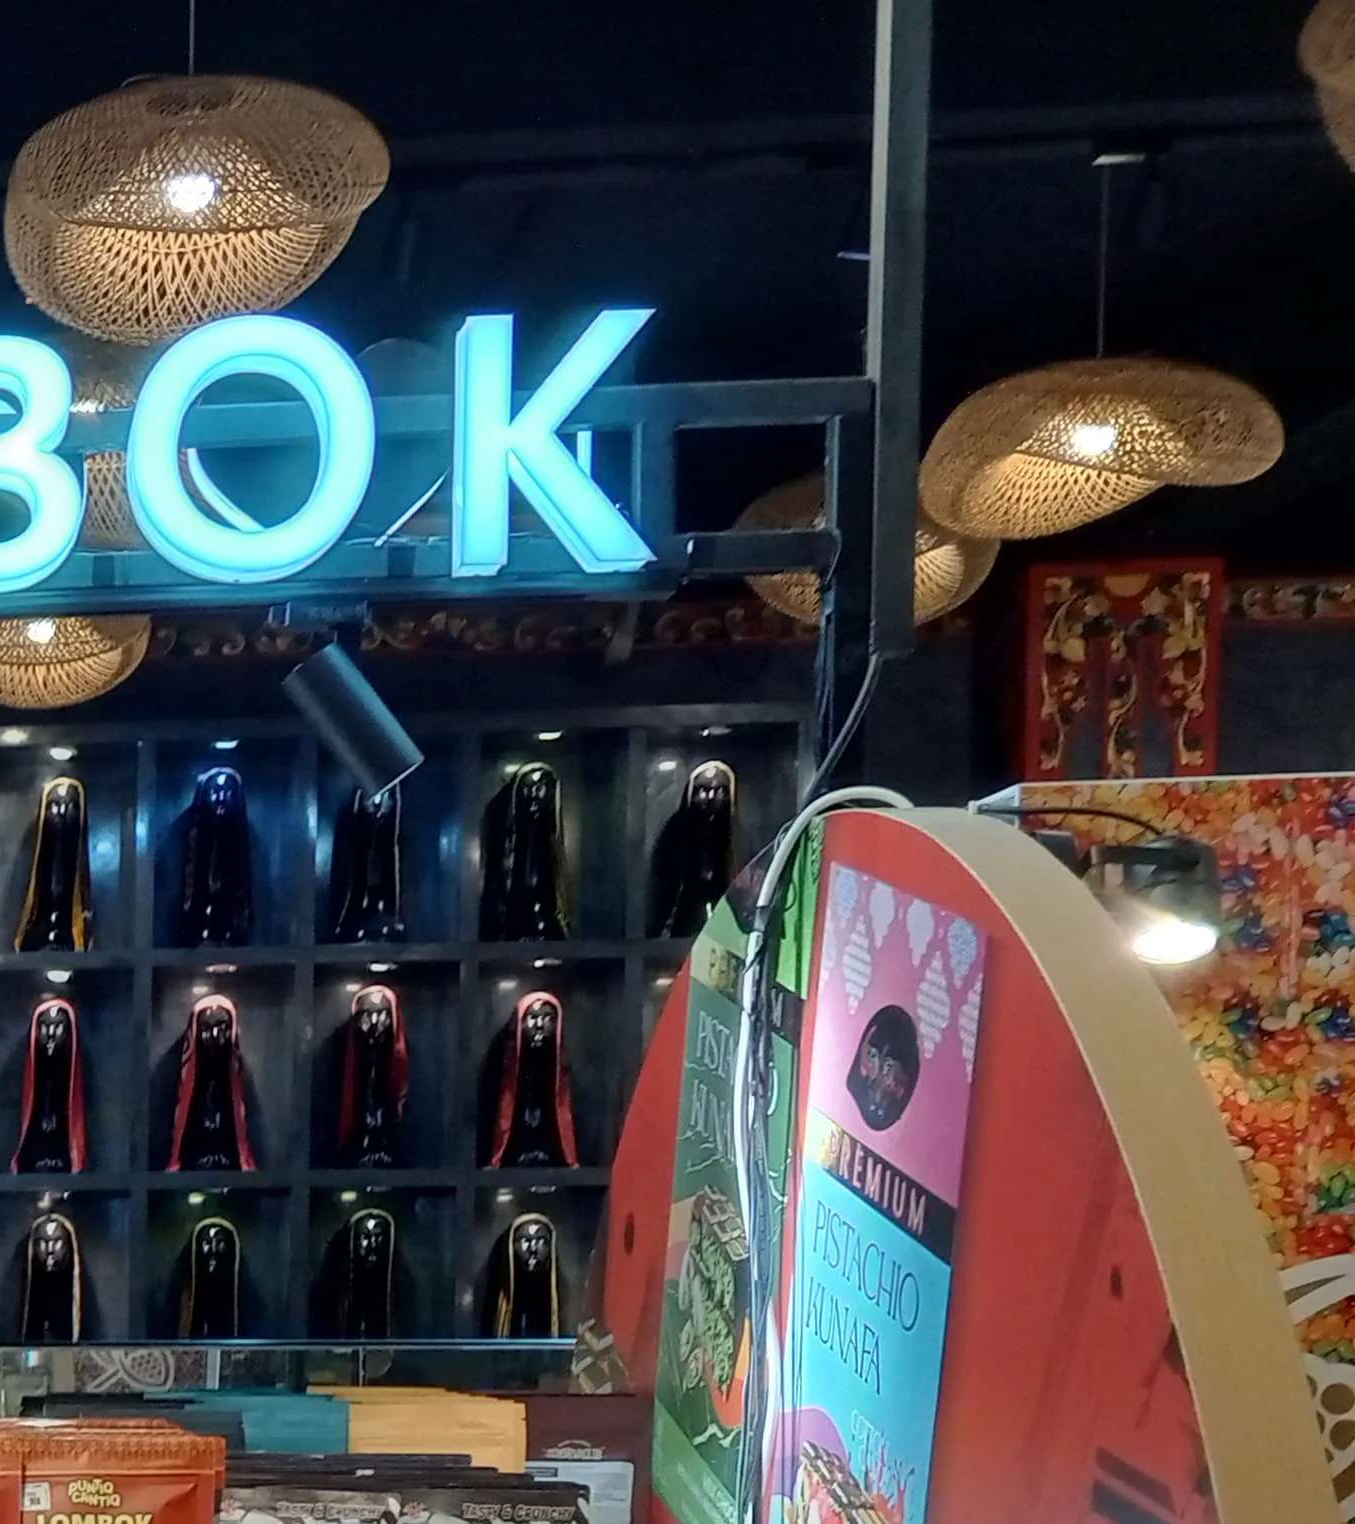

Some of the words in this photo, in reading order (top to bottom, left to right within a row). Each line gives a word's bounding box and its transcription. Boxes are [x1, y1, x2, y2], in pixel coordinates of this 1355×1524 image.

[827, 1128, 926, 1236] PREMIUM
[813, 1199, 920, 1333] PISTACHIO
[806, 1276, 883, 1395] KUNAFA
